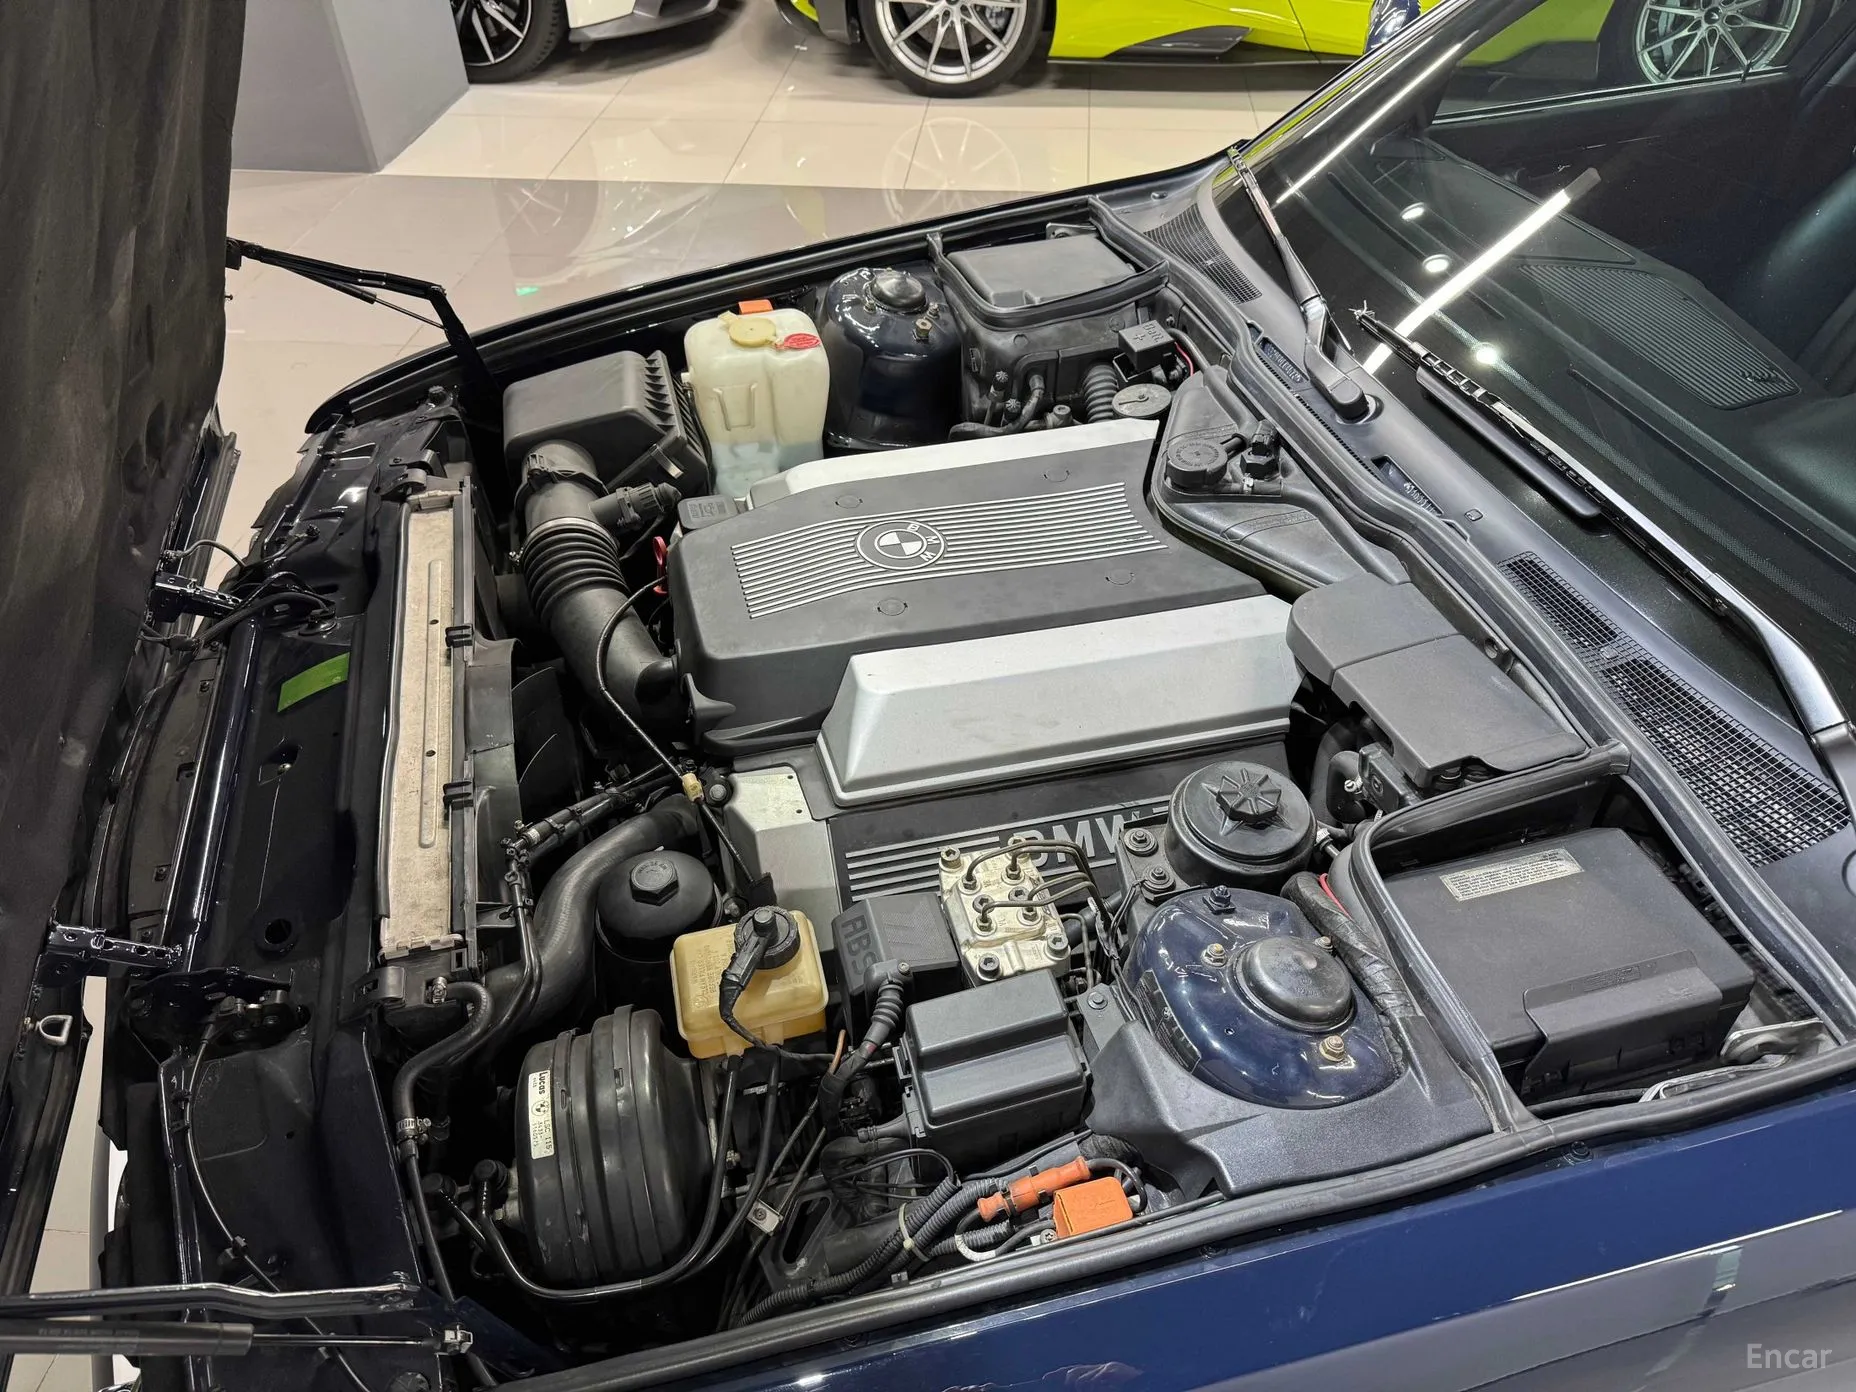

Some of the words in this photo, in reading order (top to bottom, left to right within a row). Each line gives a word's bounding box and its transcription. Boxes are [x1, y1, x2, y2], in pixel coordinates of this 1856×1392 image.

[907, 523, 940, 562] BMW
[841, 914, 880, 976] ABS
[538, 1071, 548, 1095] Lucas
